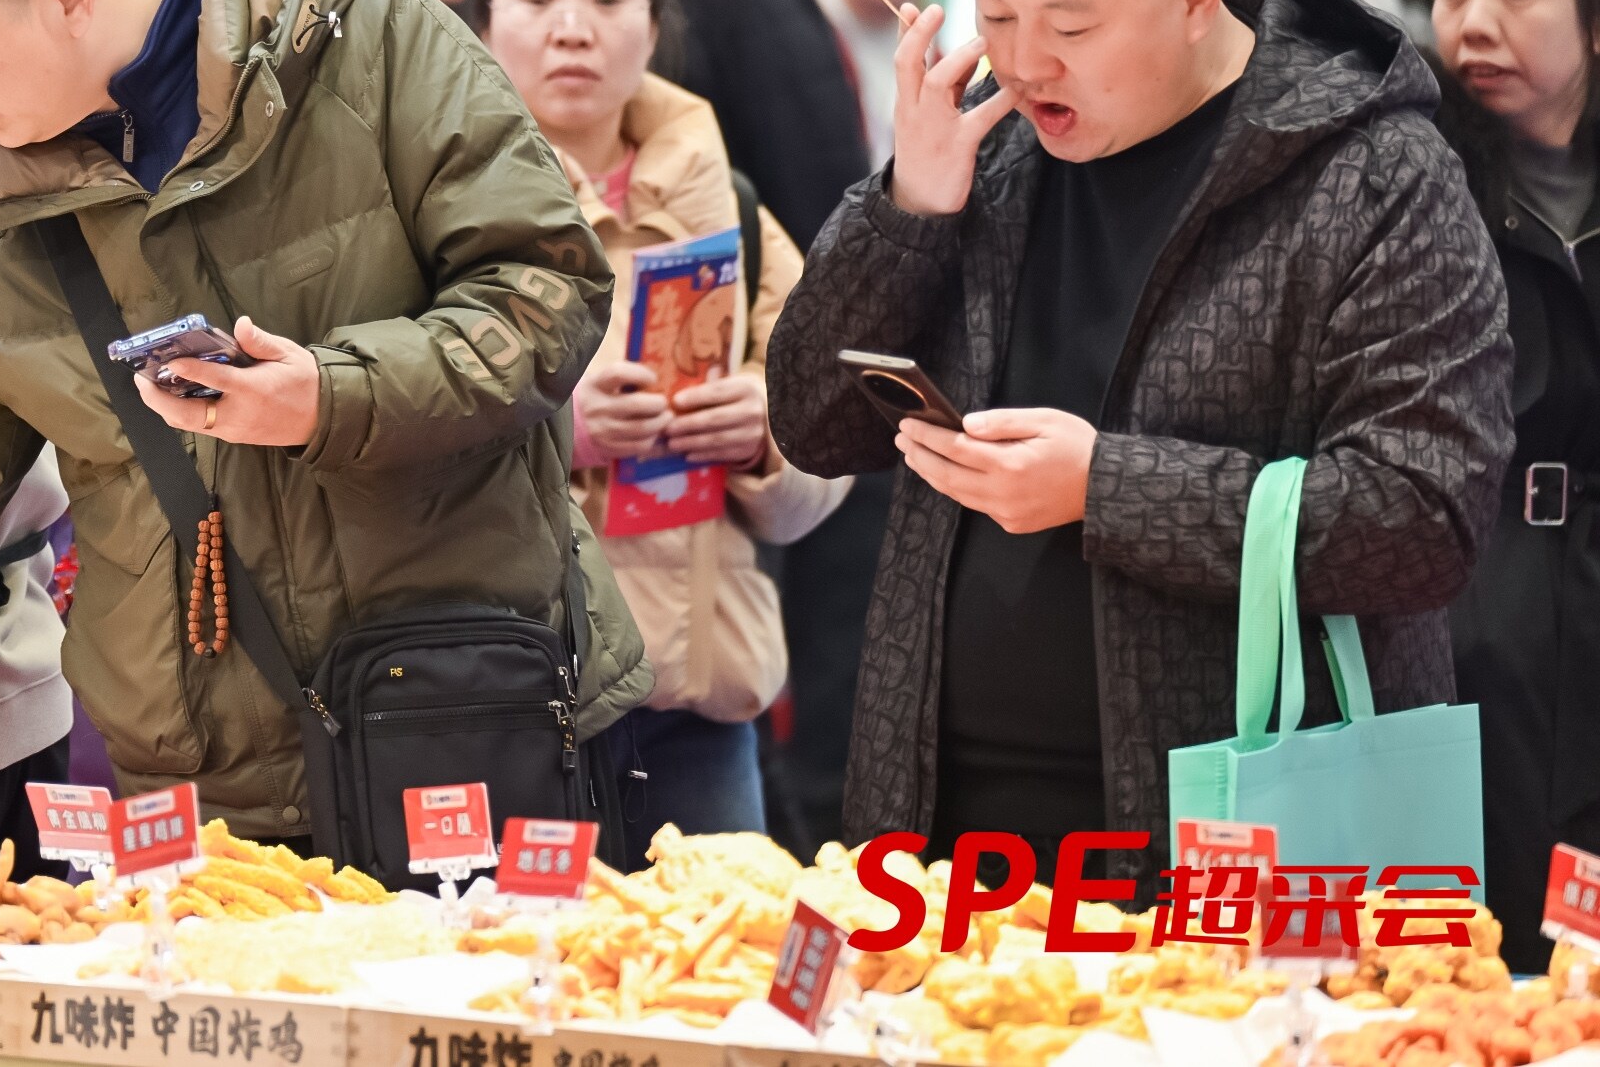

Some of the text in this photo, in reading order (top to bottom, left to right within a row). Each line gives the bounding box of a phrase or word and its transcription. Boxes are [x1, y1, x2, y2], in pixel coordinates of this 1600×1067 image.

[30, 991, 305, 1065] 九味炸 中国炸鸡
